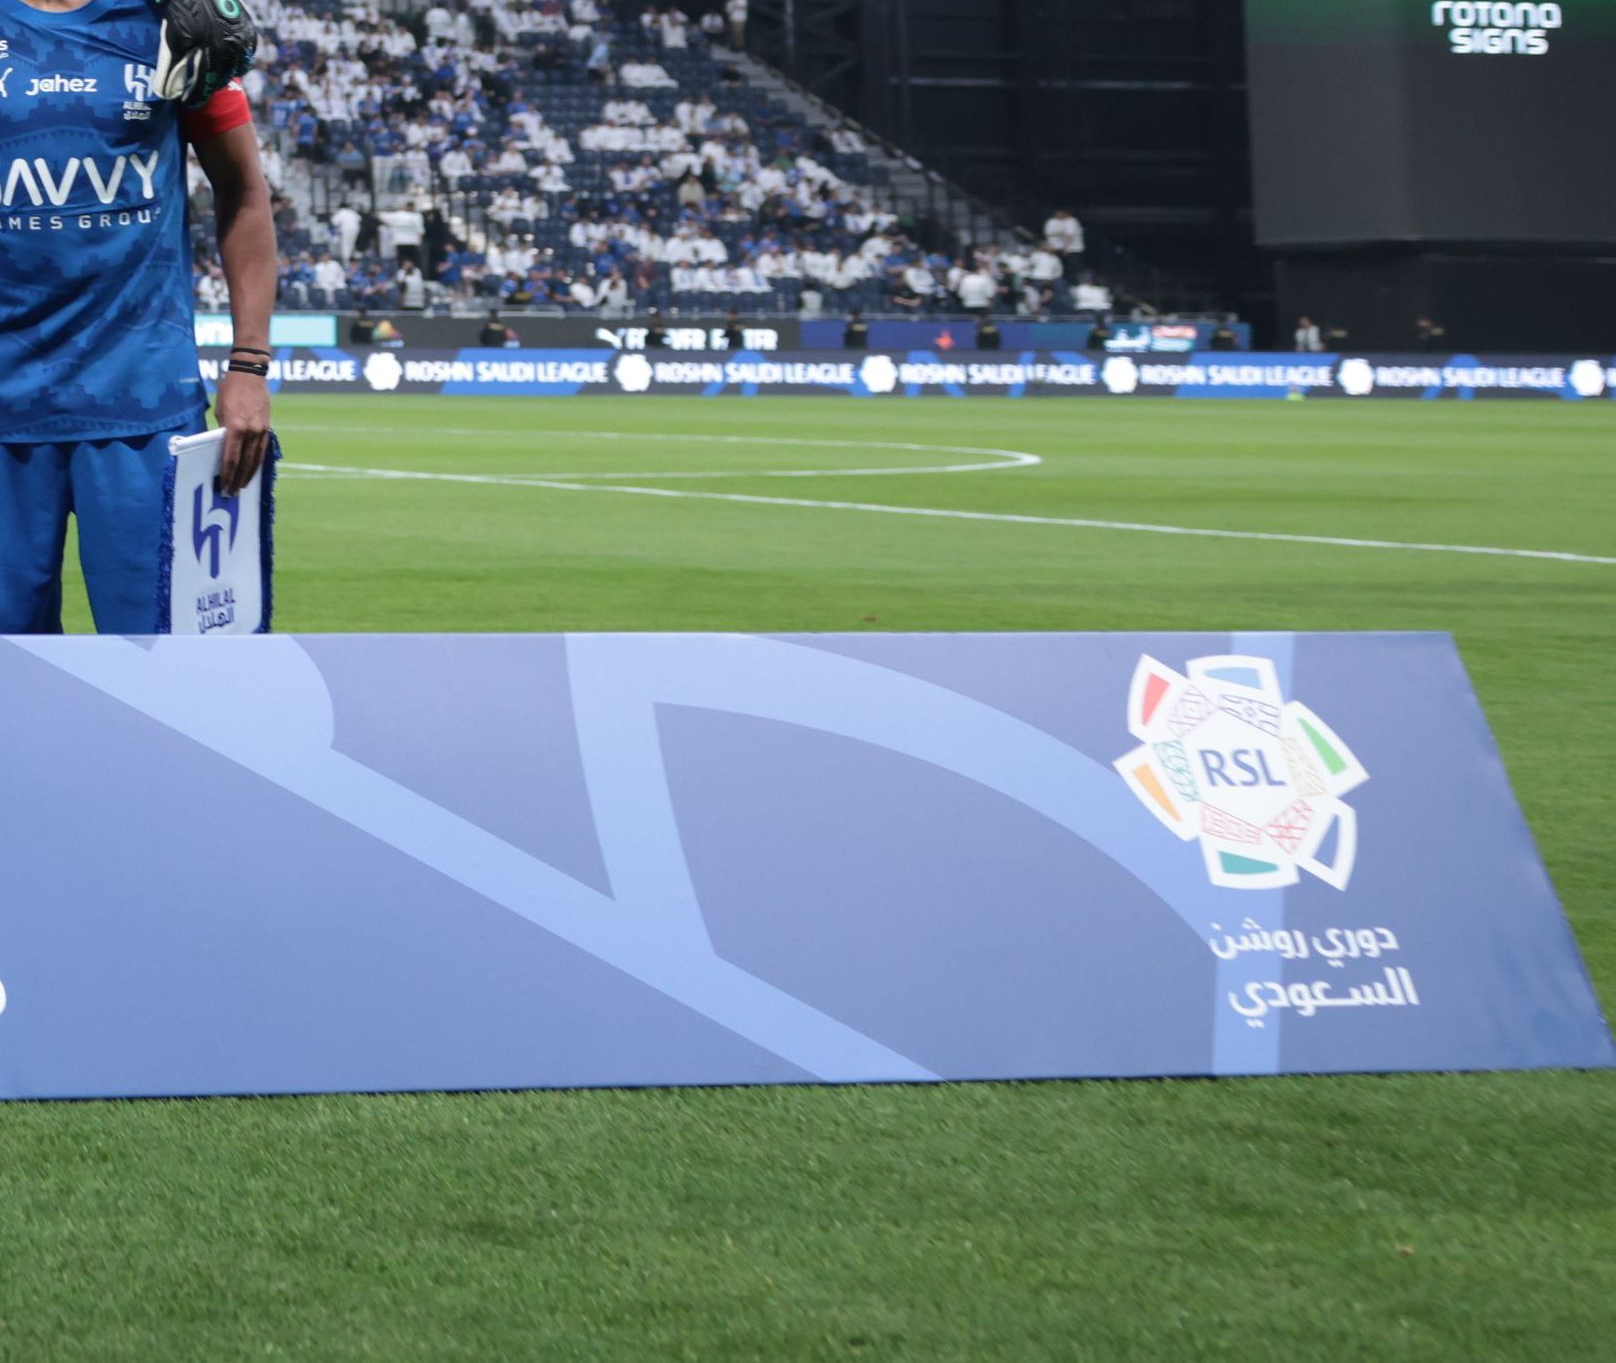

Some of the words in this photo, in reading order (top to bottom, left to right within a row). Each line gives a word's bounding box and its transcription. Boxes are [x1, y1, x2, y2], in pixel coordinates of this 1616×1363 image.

[282, 360, 355, 381] LEAGUE
[405, 361, 474, 382] ROSHN
[476, 361, 535, 382] SAUDI
[536, 362, 608, 382] LEAGUE
[655, 362, 723, 383] ROSHN
[725, 363, 783, 384] SAUDI
[784, 363, 854, 384] LEAGUE
[899, 363, 967, 384] ROSHN
[968, 364, 1025, 384] SAUDI
[1141, 365, 1206, 385] ROSHN
[1208, 366, 1264, 385] SAUDI
[1264, 366, 1331, 386] LEAGUE
[1376, 367, 1441, 386] ROSHN
[1443, 367, 1498, 387] SAUDI
[1498, 367, 1564, 387] LEAGUE
[196, 588, 236, 615] ALHILAL
[1198, 748, 1287, 787] RSL
[1208, 917, 1309, 959] روشن
[1313, 926, 1400, 968] دوري
